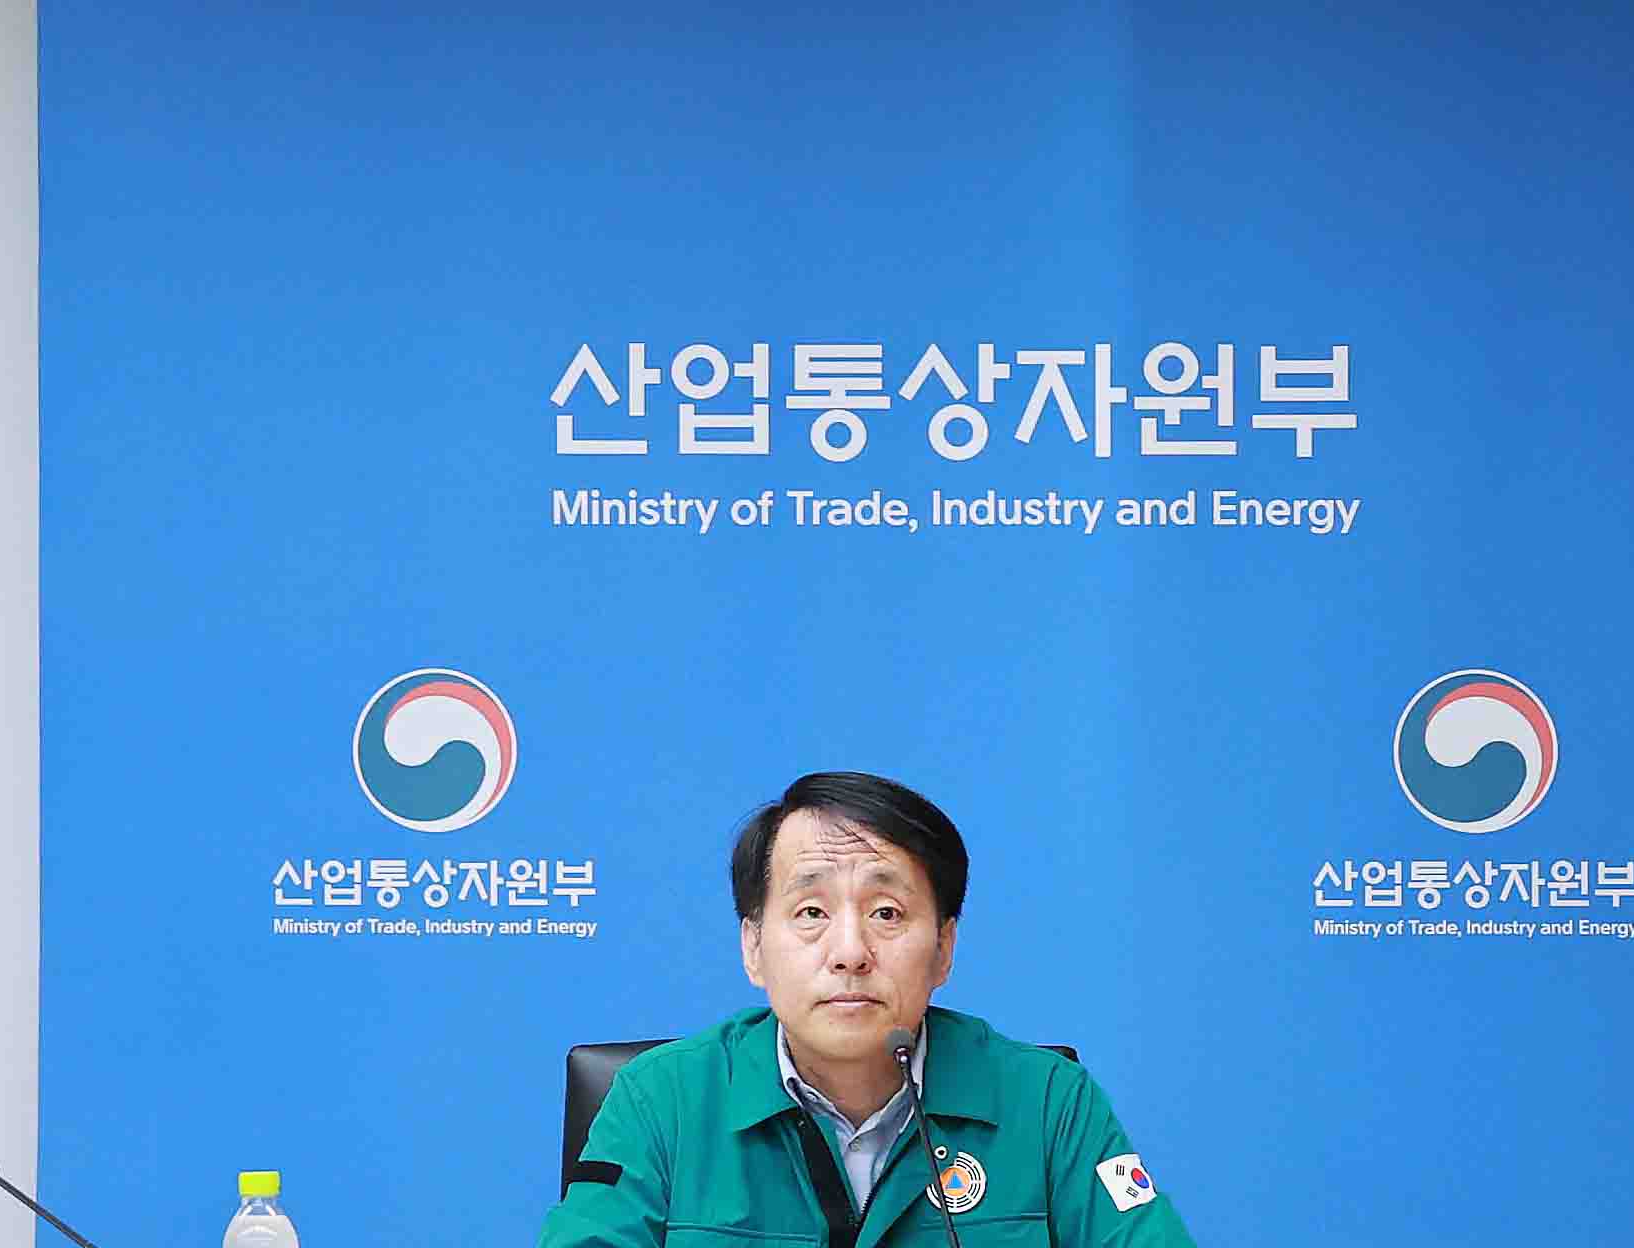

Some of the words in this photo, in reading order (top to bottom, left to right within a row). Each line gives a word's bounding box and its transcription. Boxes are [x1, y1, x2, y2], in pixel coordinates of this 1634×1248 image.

[550, 342, 1358, 462] 산업통상자원부
[552, 489, 719, 534] Ministry
[730, 490, 774, 526] of
[786, 490, 919, 533] Trade,
[932, 490, 1104, 534] Industry
[1115, 490, 1196, 526] and
[1212, 490, 1361, 534] Energy
[272, 859, 598, 909] 산업통상자원부
[273, 918, 342, 937] Ministry
[344, 918, 364, 935] of
[368, 918, 421, 938] Trade,
[425, 918, 495, 938] Industry
[498, 918, 532, 936] and
[536, 918, 598, 938] Energy
[1314, 919, 1382, 938] Ministry
[1385, 919, 1405, 936] of
[1409, 919, 1462, 938] Trade,
[1466, 919, 1537, 938] Industry
[1540, 919, 1573, 936] and
